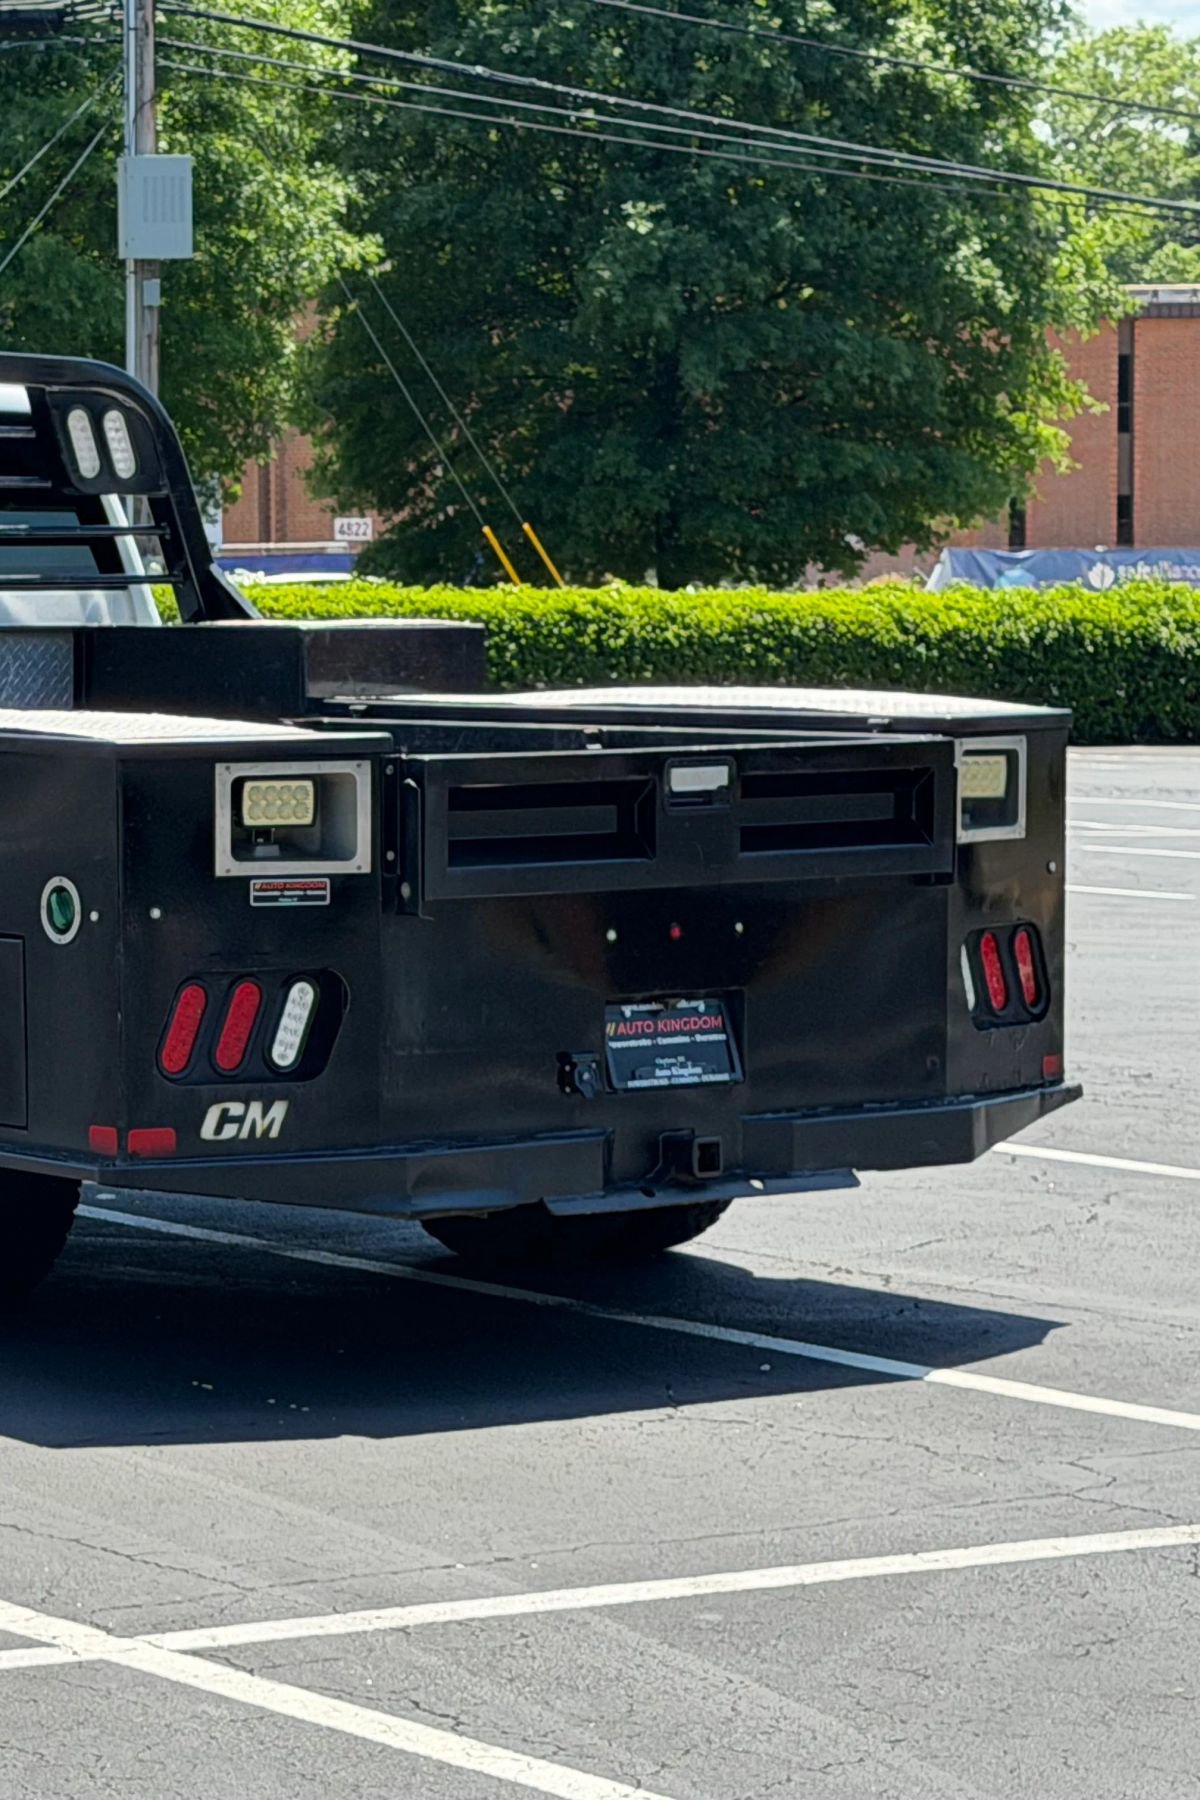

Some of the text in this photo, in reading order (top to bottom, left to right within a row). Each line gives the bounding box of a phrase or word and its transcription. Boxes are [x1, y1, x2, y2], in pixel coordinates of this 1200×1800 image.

[617, 1016, 722, 1035] AUTO KINGDOM
[200, 1100, 289, 1140] CM
